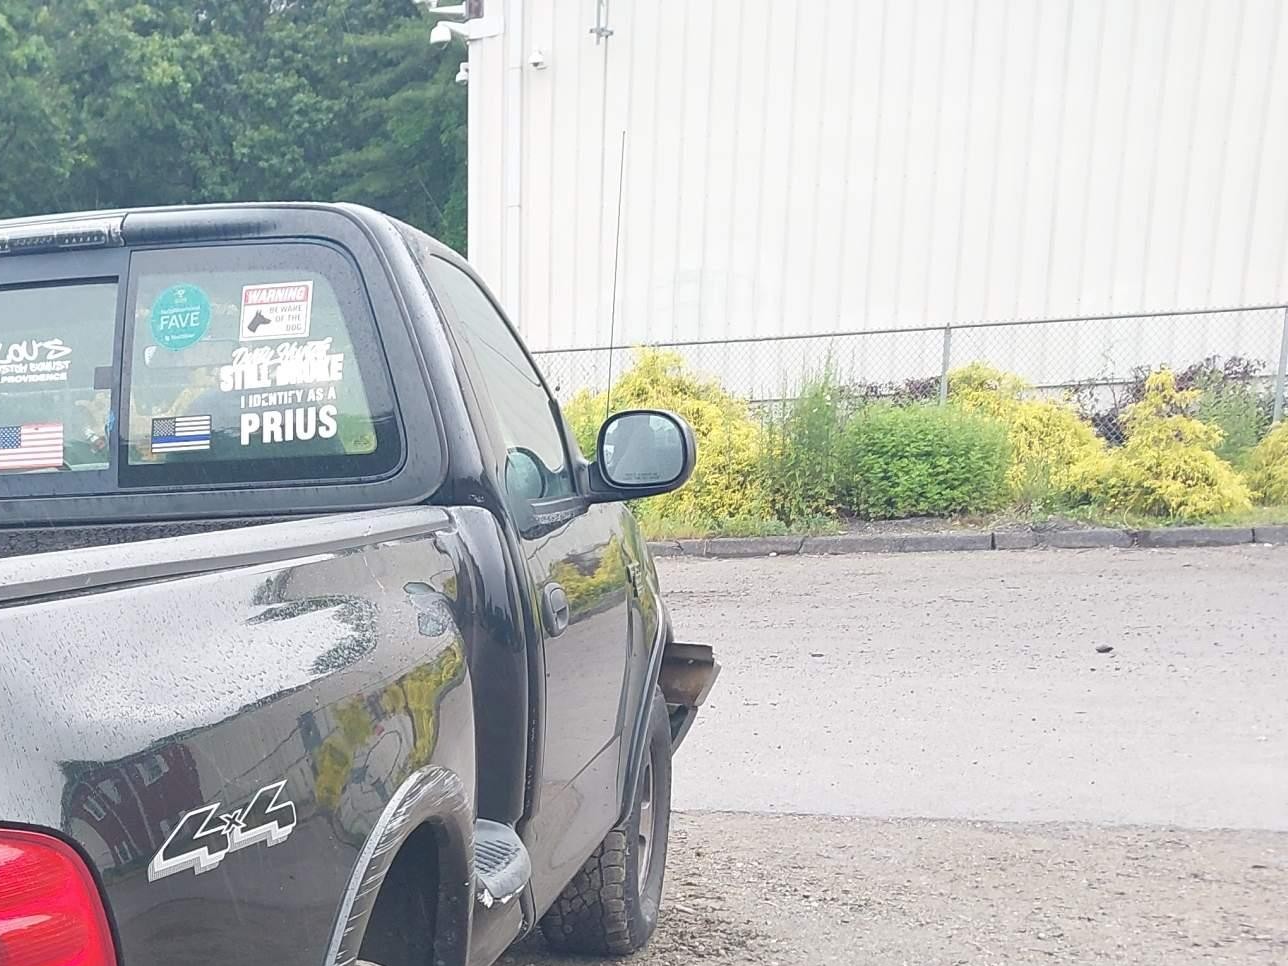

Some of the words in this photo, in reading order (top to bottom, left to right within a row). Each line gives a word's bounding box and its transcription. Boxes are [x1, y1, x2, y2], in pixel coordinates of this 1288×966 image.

[247, 287, 306, 304] WARNING
[269, 304, 303, 313] BEWARE
[159, 311, 201, 331] FAVE
[274, 314, 285, 322] OF
[287, 313, 303, 321] THE
[286, 323, 303, 332] DOG
[240, 395, 246, 409] I
[248, 389, 305, 408] IDENTIFY
[306, 387, 325, 402] AS
[327, 385, 337, 401] A
[240, 404, 338, 446] PRIUS
